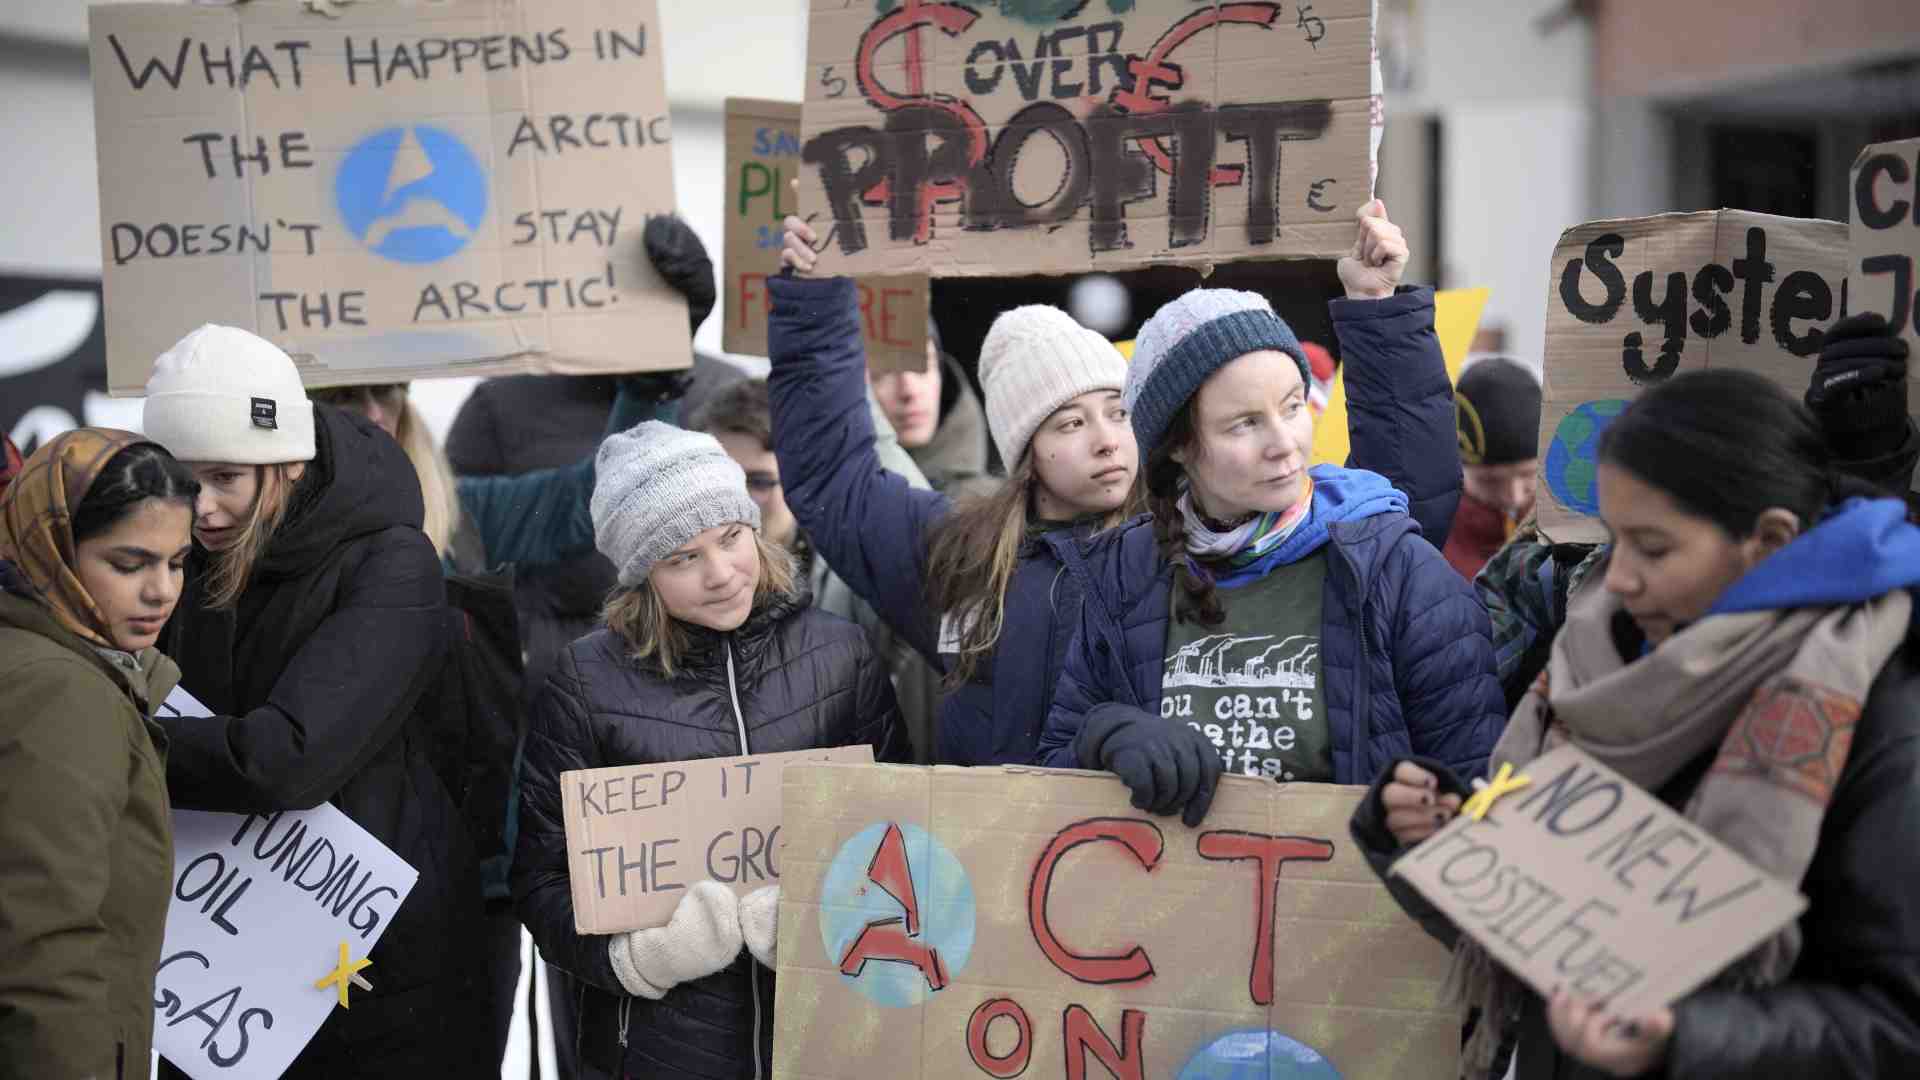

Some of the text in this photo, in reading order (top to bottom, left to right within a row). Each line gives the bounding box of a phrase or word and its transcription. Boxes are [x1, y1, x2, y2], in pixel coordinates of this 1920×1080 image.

[108, 24, 647, 91] WHAT HAPPENS IN
[963, 21, 1133, 101] OVER
[183, 115, 670, 178] THE ARCTIC
[802, 100, 1334, 256] PROFIT
[739, 161, 784, 220] PL
[111, 207, 622, 264] DOESN'T STAY
[260, 264, 619, 330] THE ARCTIC!
[1558, 227, 1848, 385] Syste
[1161, 689, 1314, 720] ou can't
[1187, 719, 1296, 750] athe
[579, 761, 760, 817] KEEP IT
[581, 838, 686, 898] THE
[1515, 763, 1762, 923] NO NEW
[175, 852, 252, 935] OIL
[840, 816, 1335, 1006] ACT
[966, 998, 1146, 1080] ON
